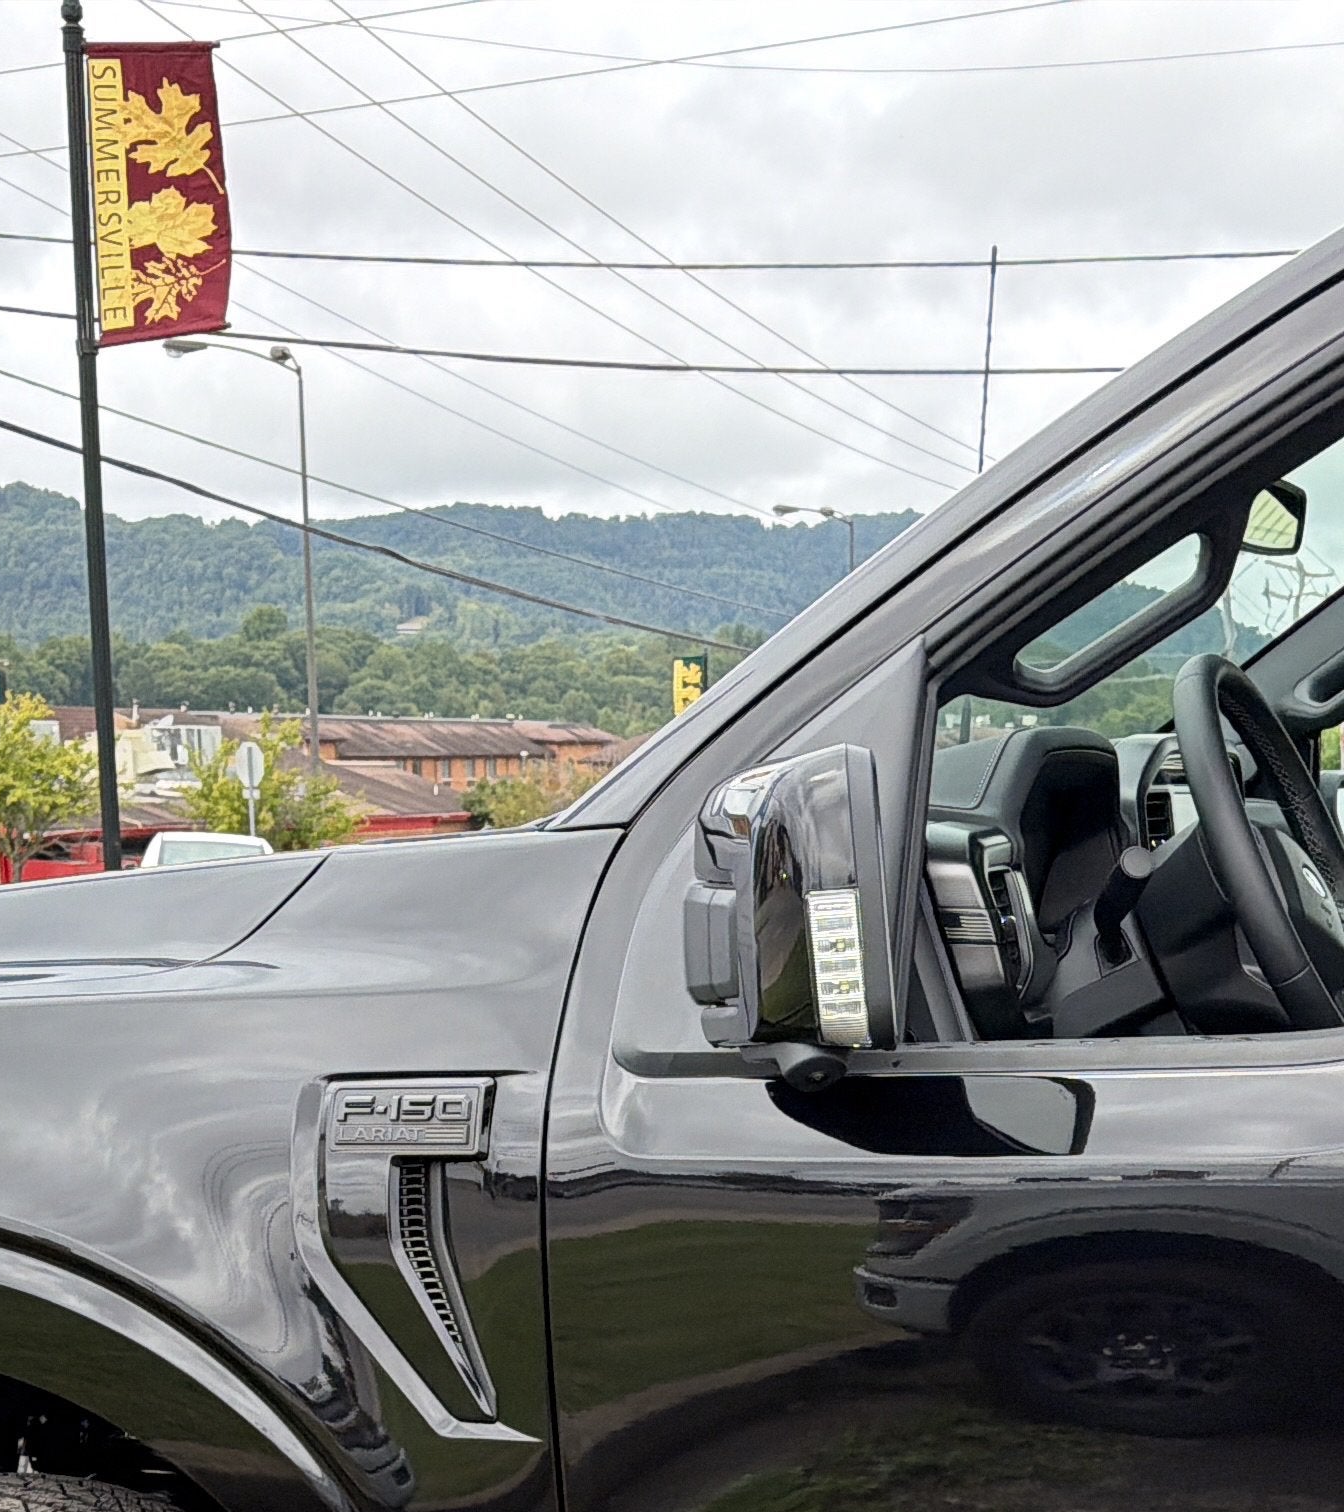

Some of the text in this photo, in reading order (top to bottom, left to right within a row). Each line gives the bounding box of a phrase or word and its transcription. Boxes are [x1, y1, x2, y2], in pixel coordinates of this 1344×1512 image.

[91, 65, 127, 322] SUMMERSVILLE
[337, 1095, 472, 1122] F-150
[337, 1127, 425, 1142] LARIAT
